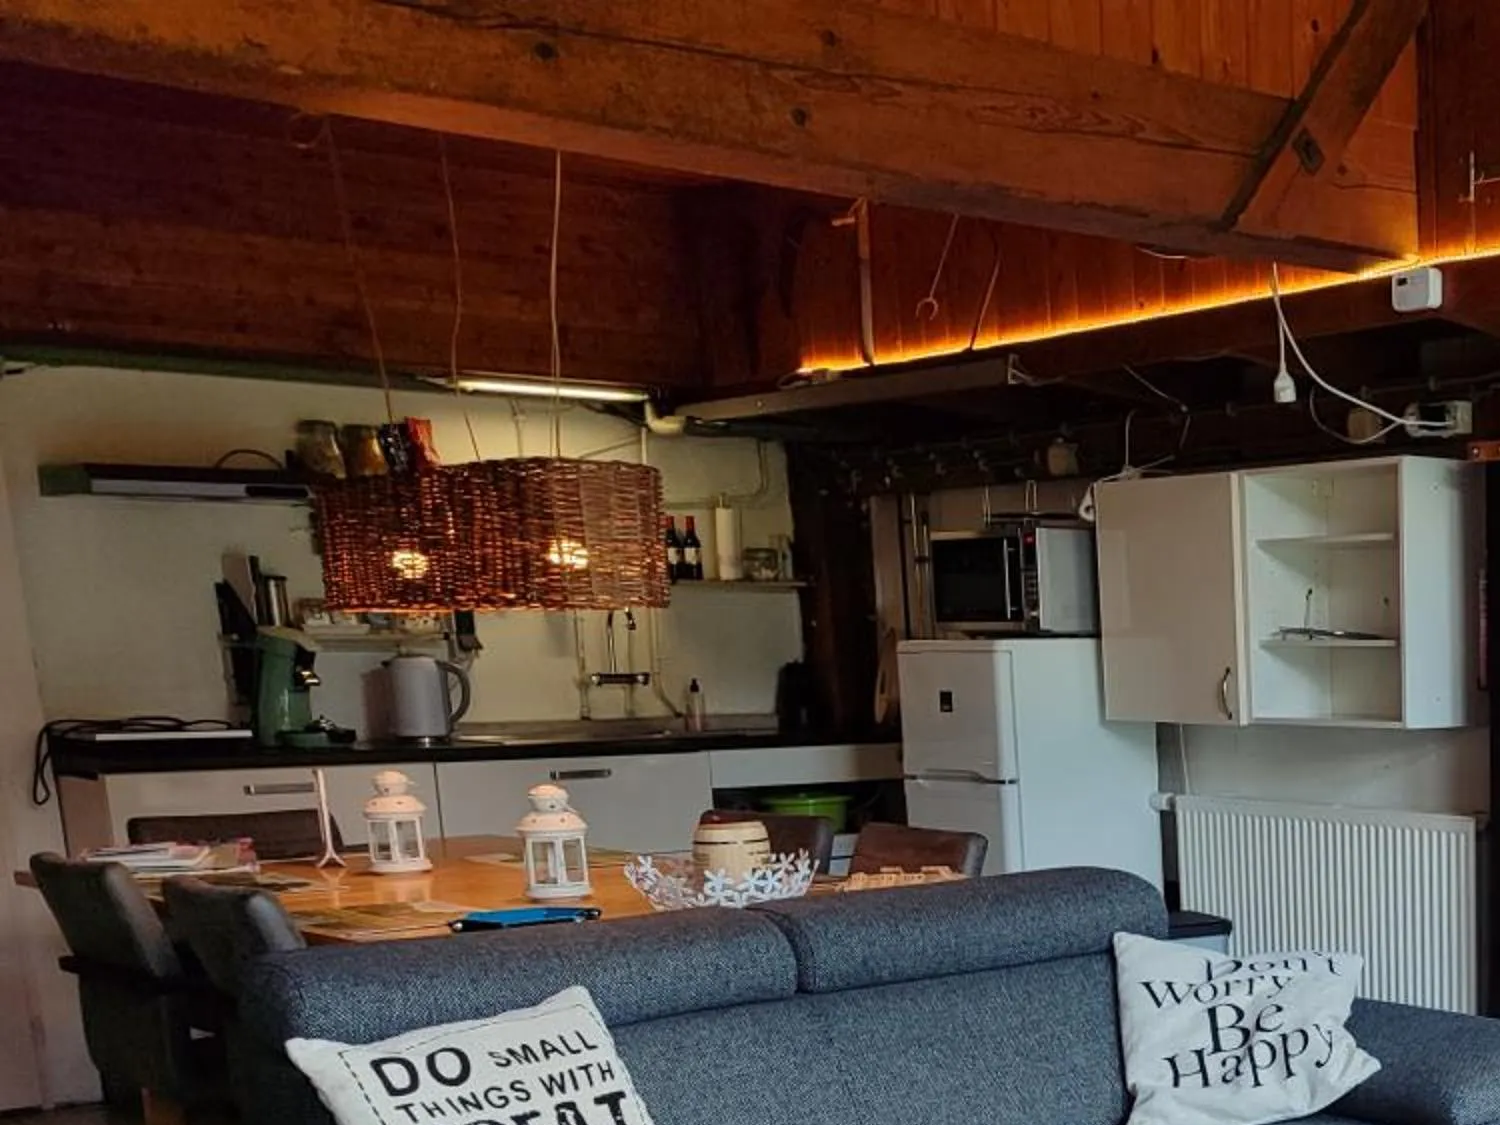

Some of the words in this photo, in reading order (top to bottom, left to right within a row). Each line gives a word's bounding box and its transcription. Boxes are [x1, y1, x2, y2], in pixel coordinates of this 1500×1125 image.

[1138, 974, 1293, 1009] Worry
[1163, 1023, 1334, 1089] Happy
[1206, 1002, 1285, 1056] Be
[370, 1046, 471, 1097] DO
[487, 1030, 599, 1068] SMALL
[395, 1079, 531, 1123] THINGS
[541, 1061, 616, 1096] WITH
